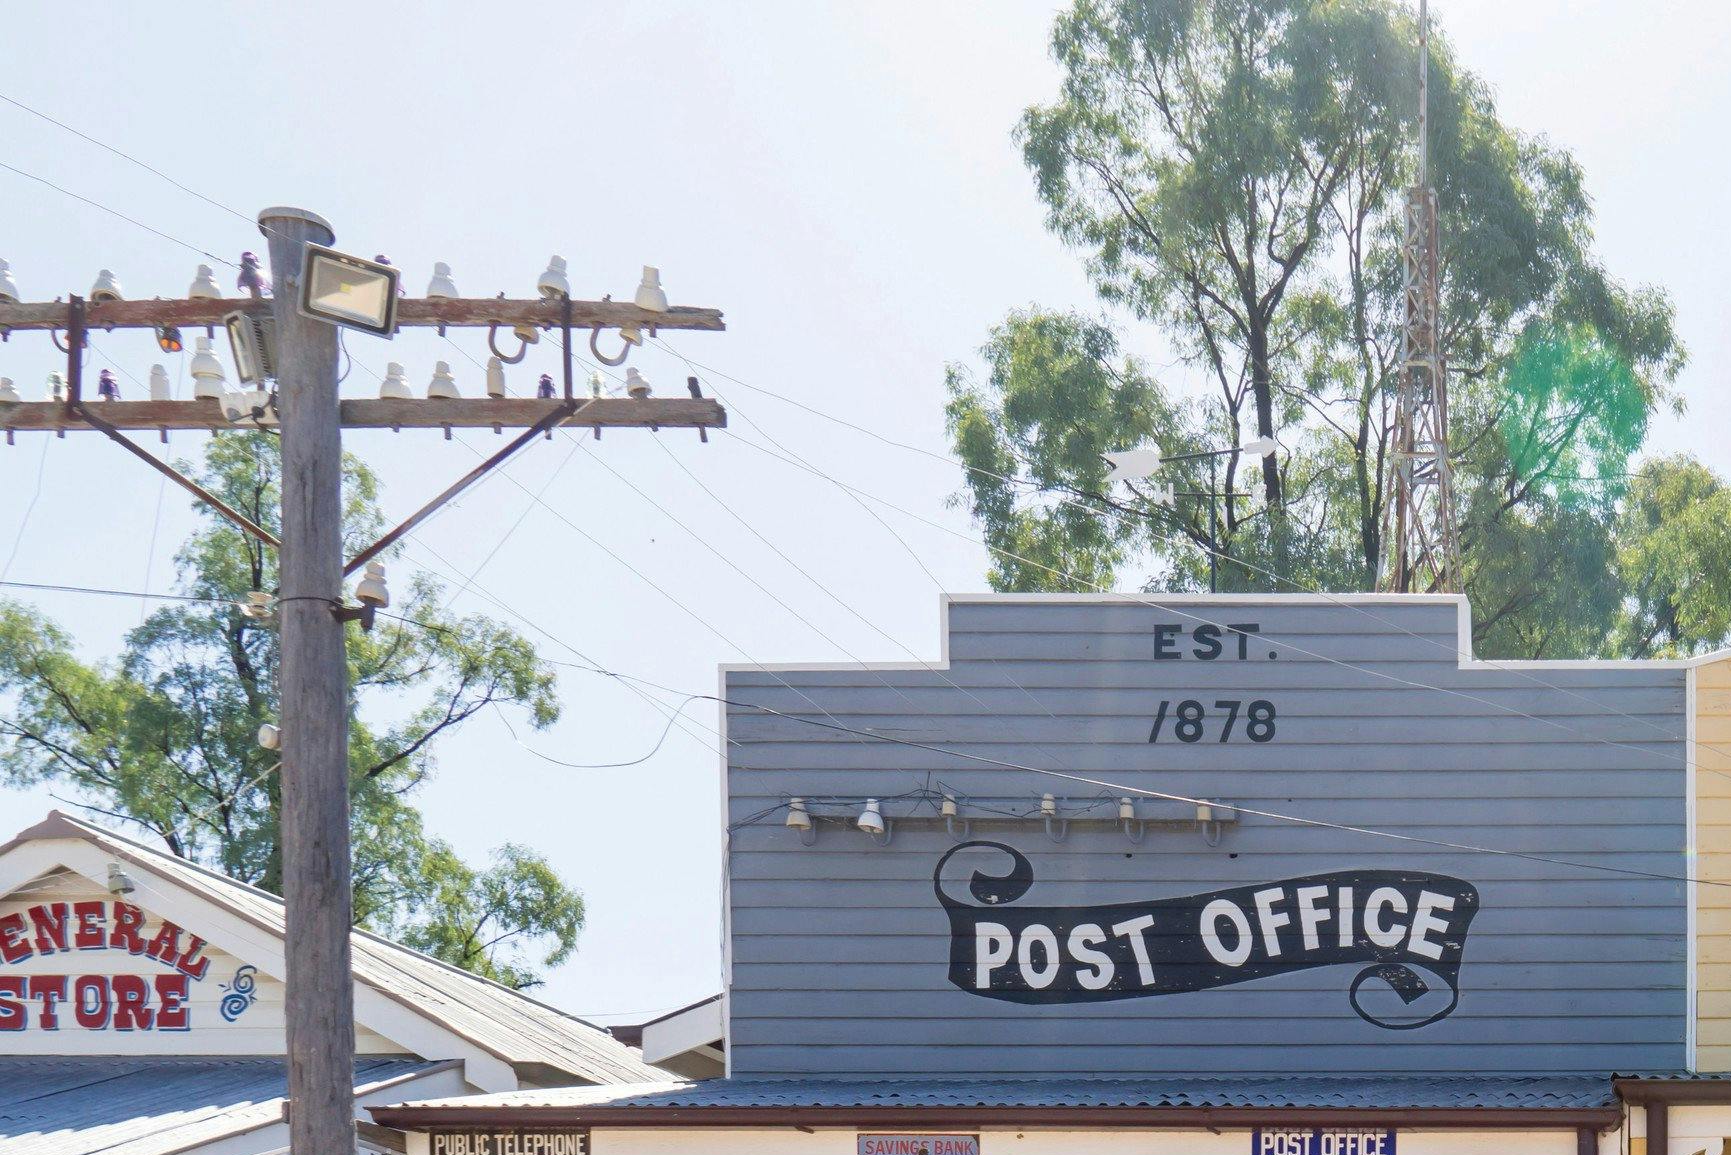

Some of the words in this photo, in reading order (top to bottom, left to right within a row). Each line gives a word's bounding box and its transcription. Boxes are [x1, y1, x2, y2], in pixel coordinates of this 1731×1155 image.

[1153, 623, 1278, 661] EST.
[1148, 699, 1277, 744] 1878
[0, 900, 211, 982] ENERAL
[974, 914, 1155, 990] POST
[1199, 885, 1456, 968] OFFICE
[0, 974, 191, 1031] STORE
[934, 1140, 974, 1155] BANK
